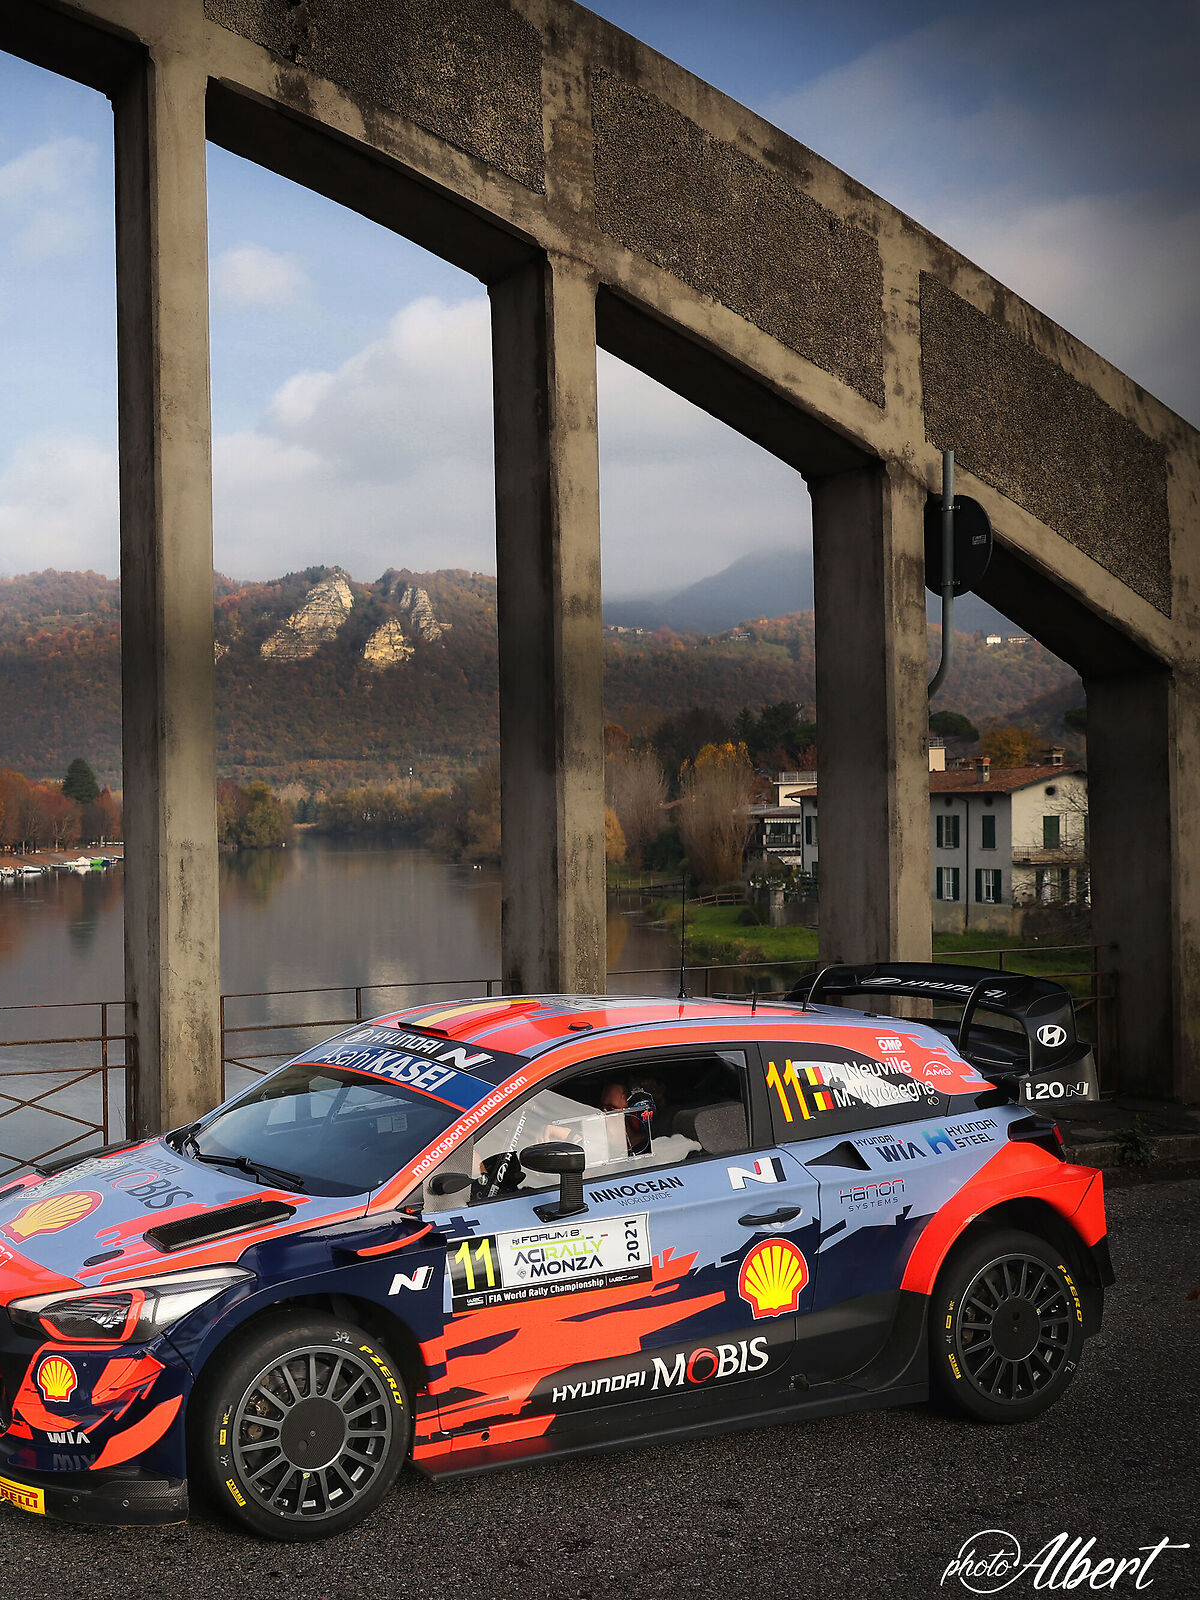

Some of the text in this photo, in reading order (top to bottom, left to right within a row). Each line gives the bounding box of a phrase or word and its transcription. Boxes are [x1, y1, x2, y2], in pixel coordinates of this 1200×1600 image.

[368, 1031, 445, 1054] HYUNDAI
[877, 1039, 904, 1051] OMP
[843, 1057, 913, 1081] Neuville
[765, 1058, 811, 1123] 11
[832, 1079, 935, 1108] M. Wydaeghe
[1025, 1081, 1065, 1101] i20
[411, 1075, 528, 1177] motorsport.hyundai.com
[944, 1118, 998, 1137] HYUNDAI
[854, 1134, 896, 1147] HYUNDAI
[954, 1131, 996, 1149] STEEL
[93, 1163, 194, 1210] MOBIS
[588, 1175, 685, 1204] INNOCEAN
[617, 1191, 673, 1207] WORLDWIDE
[848, 1196, 899, 1213] SYSTEMS
[624, 1220, 640, 1262] 2021
[454, 1238, 496, 1291] 11
[530, 1255, 604, 1278] MONZA
[488, 1290, 502, 1304] FIA
[503, 1287, 527, 1302] World
[528, 1284, 549, 1299] Rally
[550, 1278, 604, 1294] Championship
[552, 1336, 769, 1404] HYUNDAI MOBIS
[46, 1430, 91, 1445] WIA
